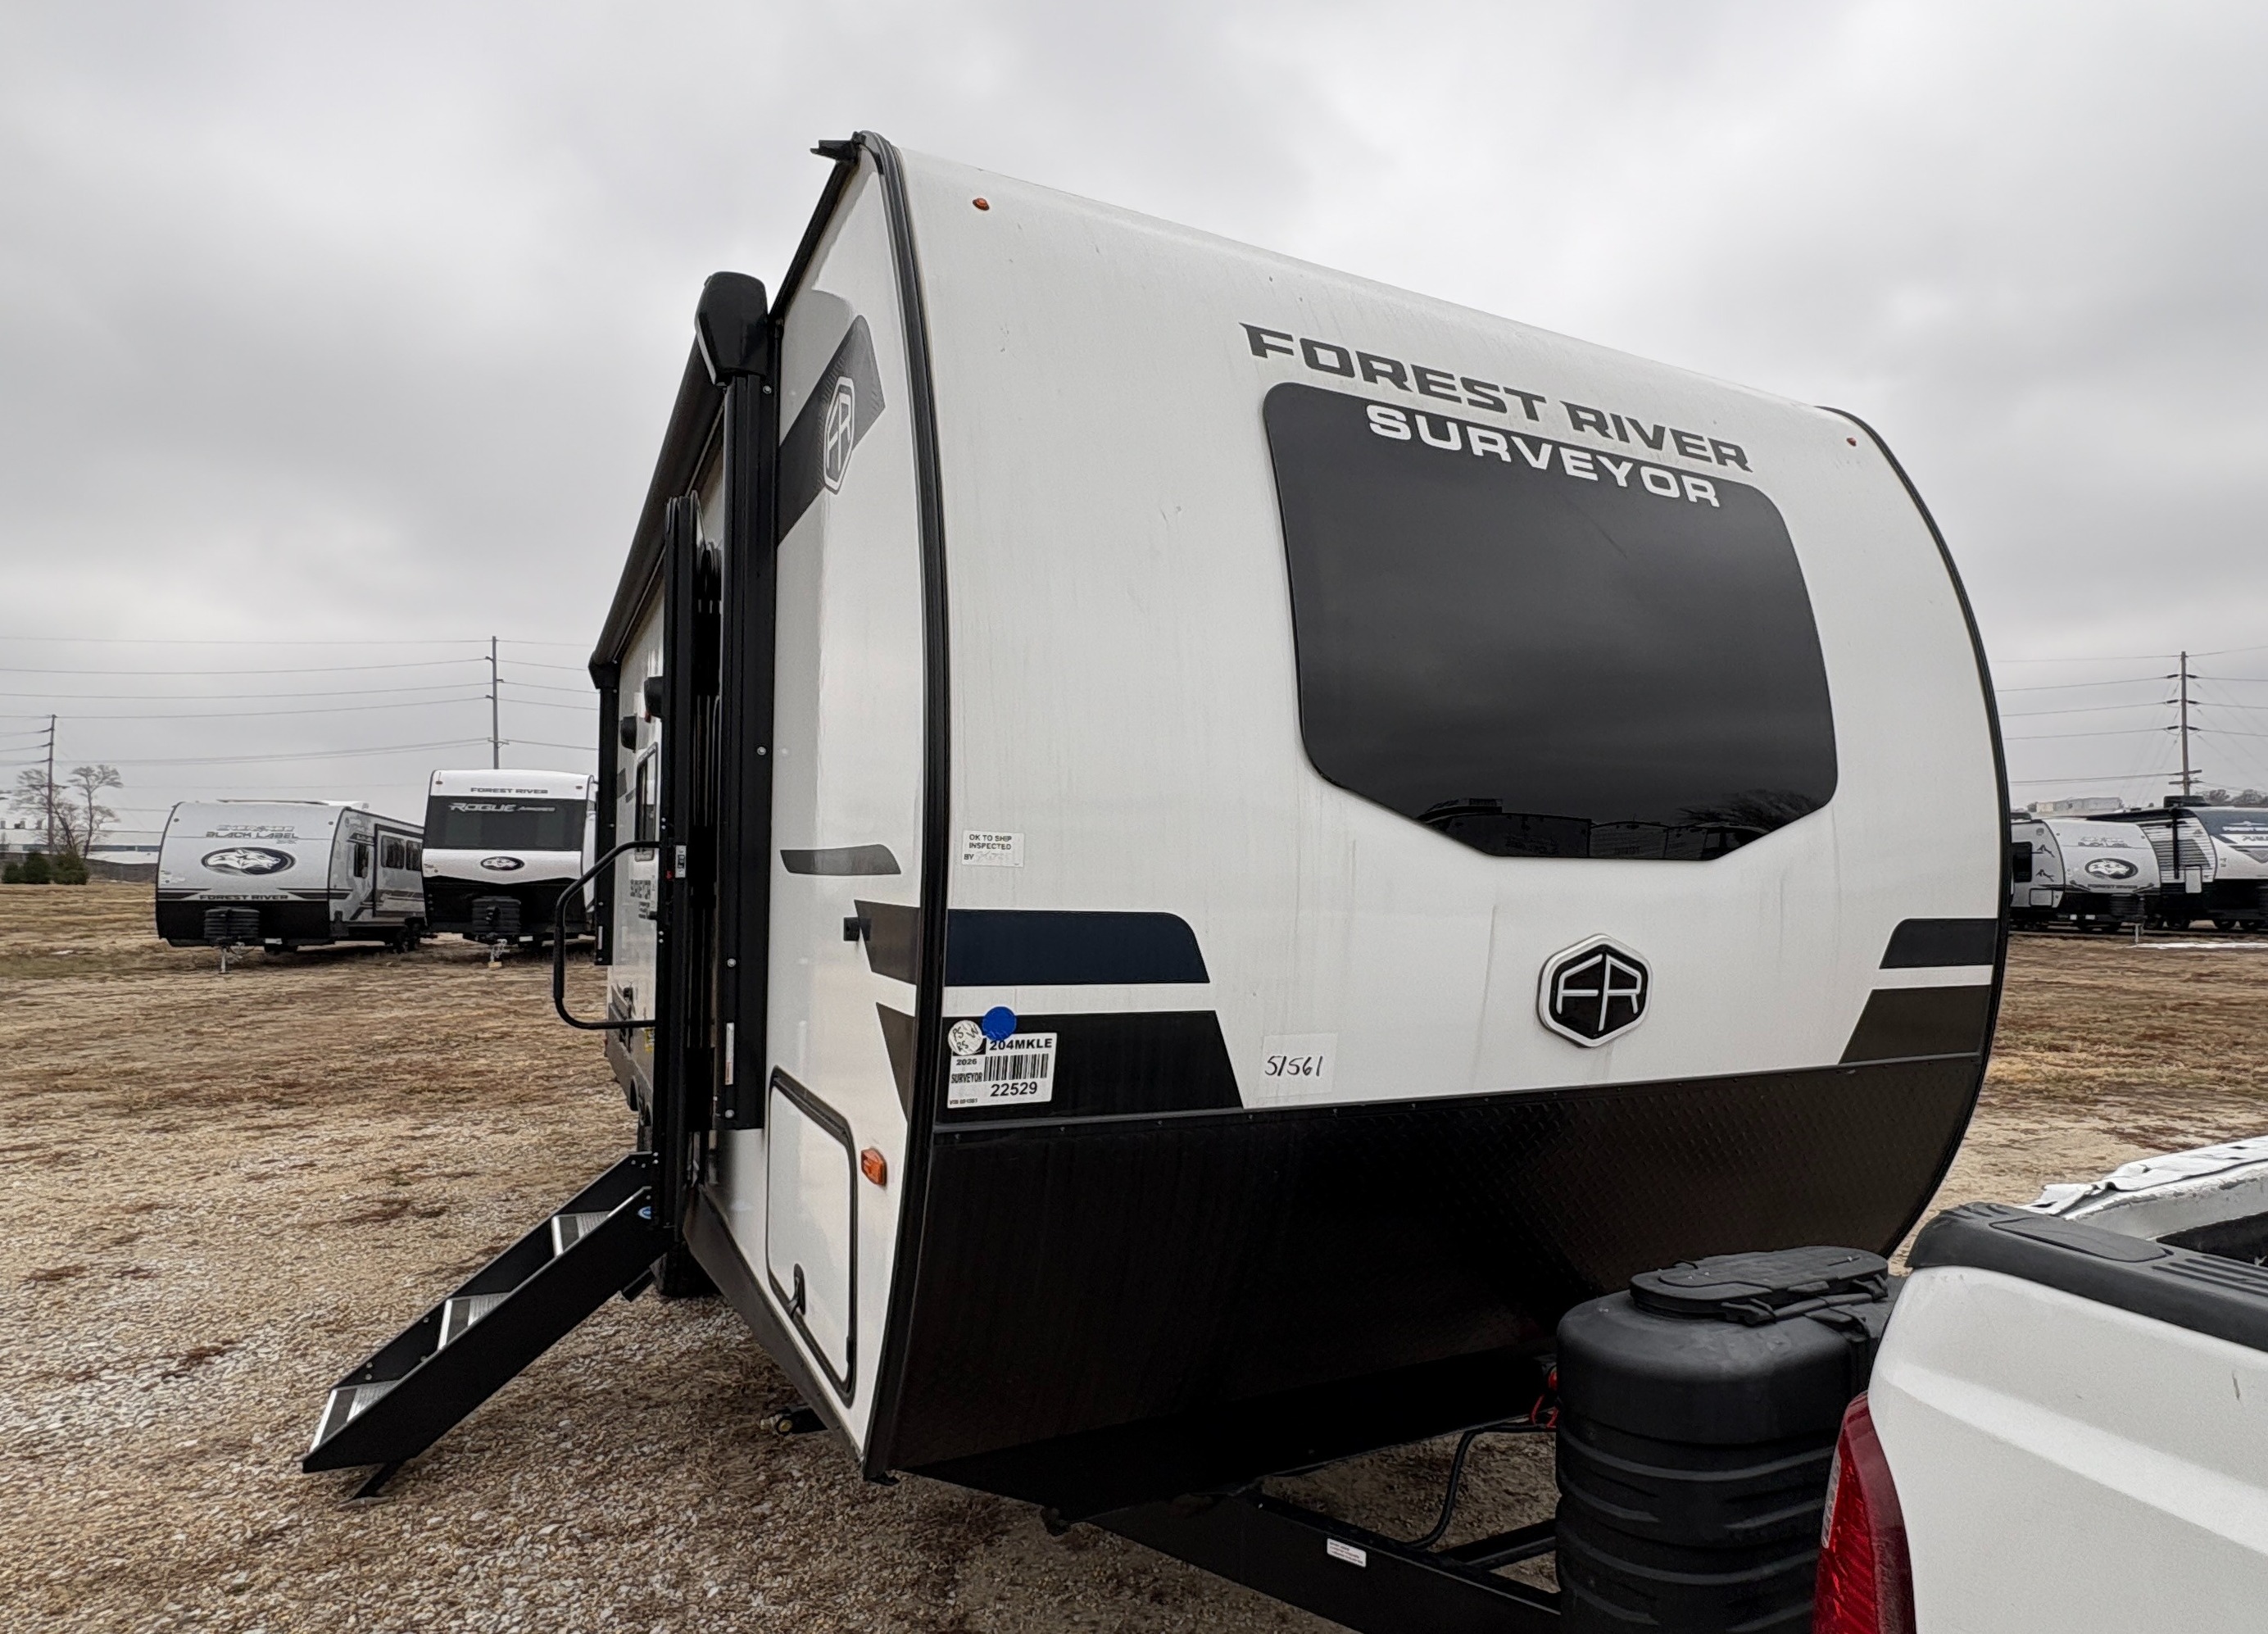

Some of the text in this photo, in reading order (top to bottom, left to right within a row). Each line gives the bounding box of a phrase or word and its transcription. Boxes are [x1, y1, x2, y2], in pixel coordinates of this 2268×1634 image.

[1239, 322, 1754, 473] FOREST RIVER
[1366, 405, 1721, 508] SURVEYOR
[448, 802, 517, 812] ROGUE
[968, 842, 1012, 851] INSPECTED
[989, 1037, 1053, 1051] 204MKLE
[955, 1058, 978, 1066] 2026
[1264, 1055, 1323, 1077] 51561
[990, 1082, 1038, 1097] 22529
